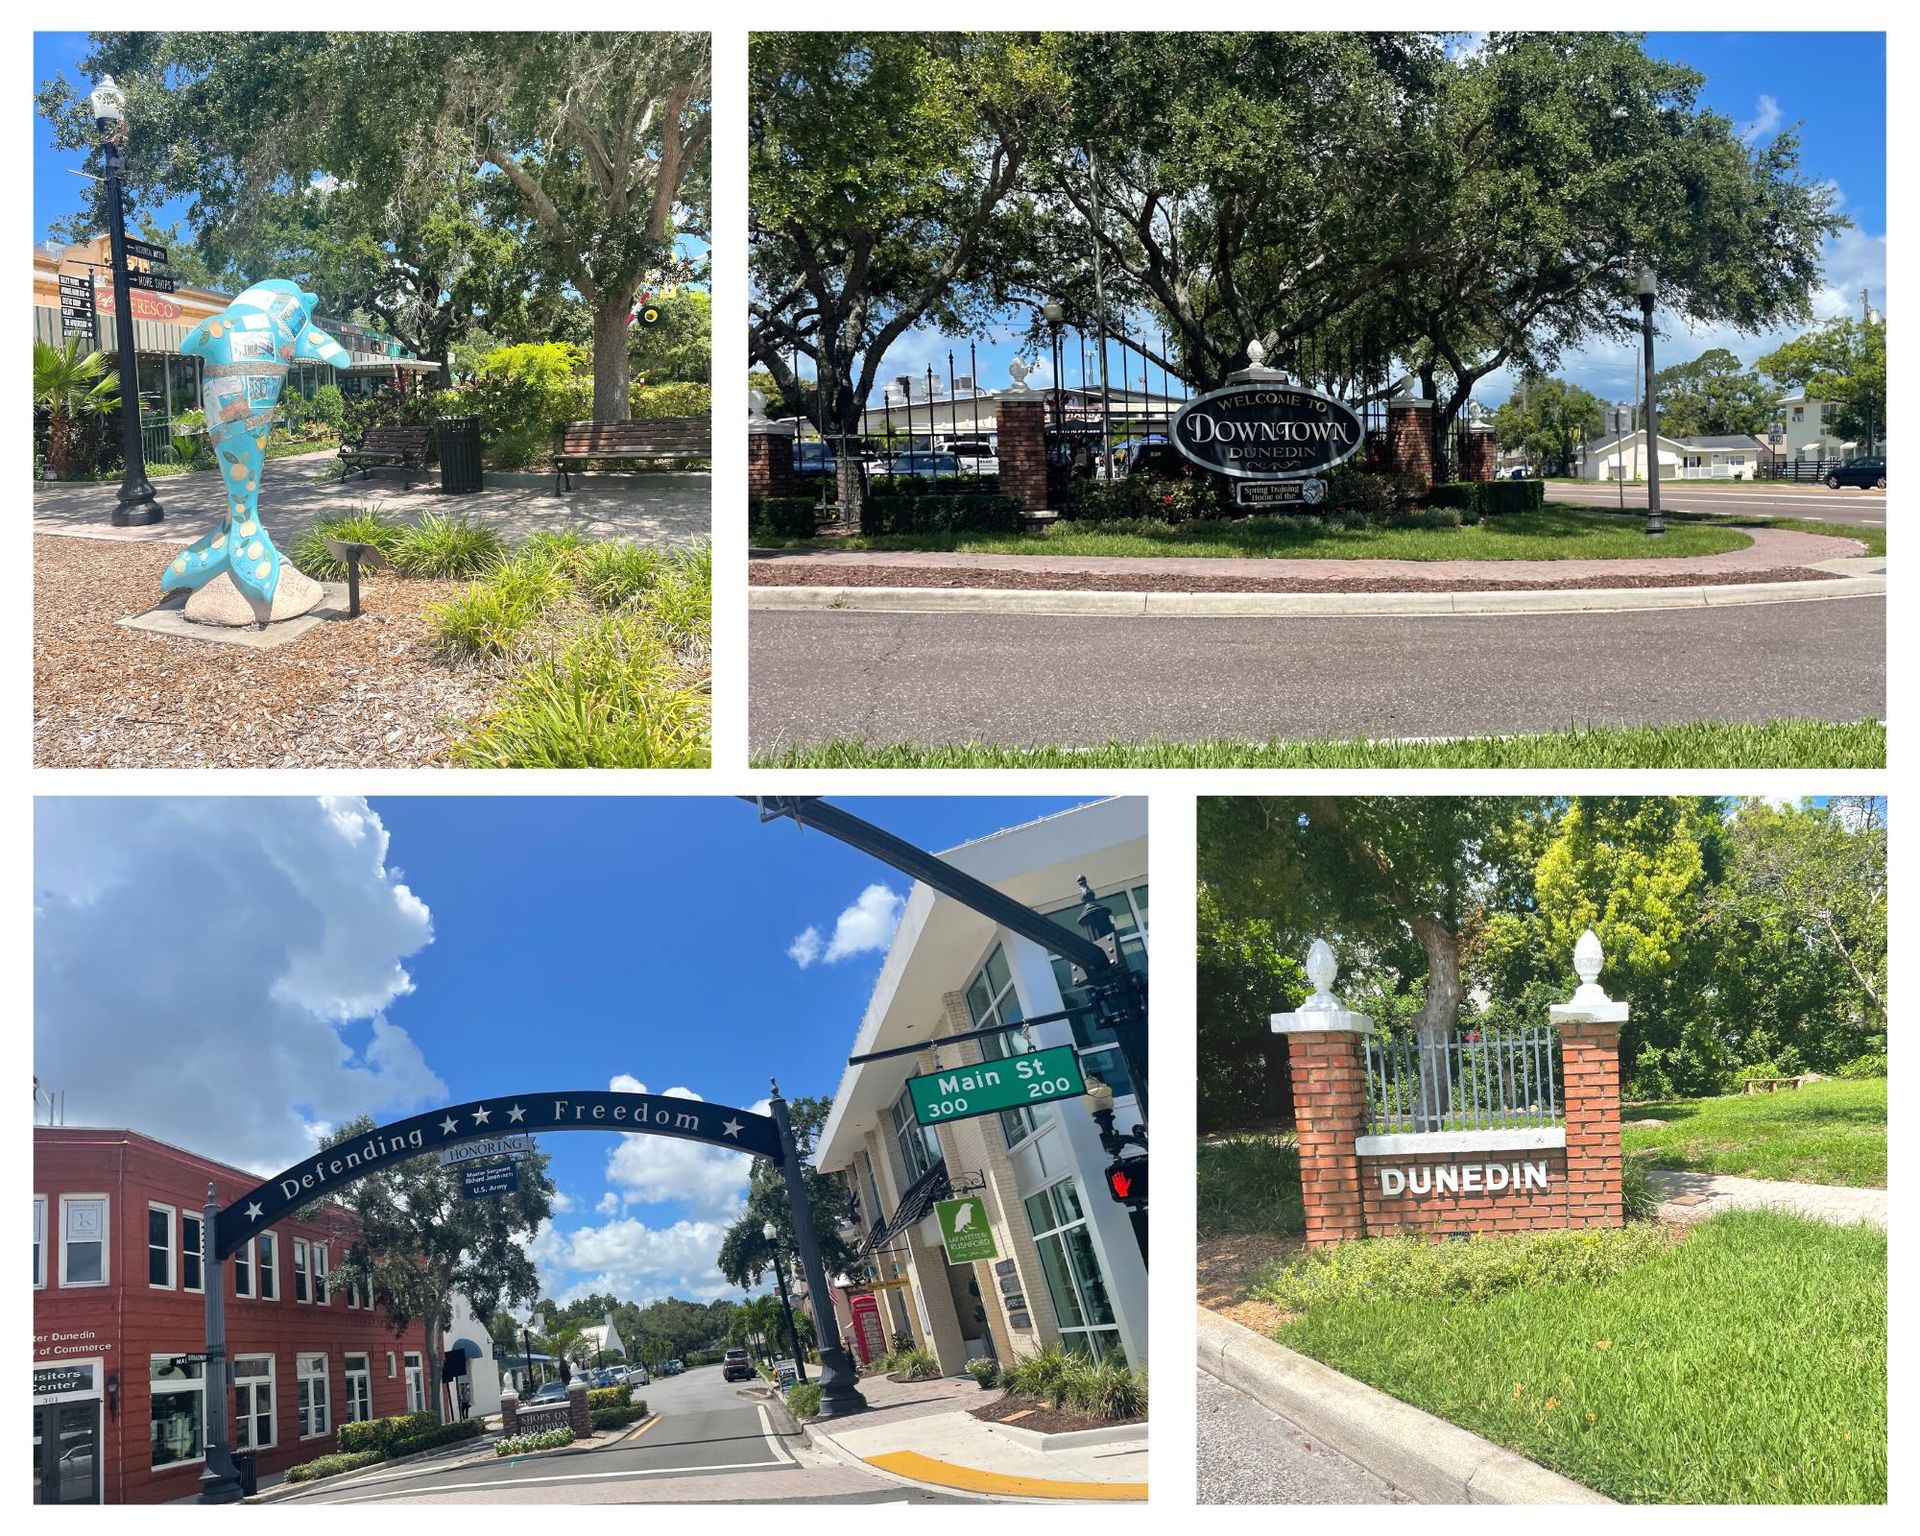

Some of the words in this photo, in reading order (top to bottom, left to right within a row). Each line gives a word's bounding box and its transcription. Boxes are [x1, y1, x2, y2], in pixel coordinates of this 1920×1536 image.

[138, 275, 154, 288] MORE
[155, 278, 172, 291] SHOPS
[1217, 392, 1301, 411] WELCOME
[1308, 399, 1328, 413] TO
[1229, 446, 1316, 459] DUNEDIN
[1244, 486, 1268, 495] Spring
[1270, 485, 1299, 494] Training
[1251, 493, 1274, 501] Home
[1284, 492, 1296, 500] the
[938, 1070, 1000, 1096] Main
[1015, 1058, 1045, 1080] St
[1027, 1077, 1070, 1098] 200
[927, 1098, 968, 1118] 300
[280, 1129, 423, 1200] Defending
[554, 1100, 700, 1131] Freedom
[449, 1138, 522, 1161] HONORING
[1380, 1161, 1548, 1197] DUNEDIN
[473, 1186, 488, 1194] U.S.
[489, 1183, 508, 1192] Army
[950, 1238, 990, 1250] RUSHFORD
[52, 1331, 95, 1341] Dunedin
[39, 1346, 51, 1355] of
[54, 1343, 112, 1354] Commerce
[42, 1396, 58, 1404] 301
[521, 1412, 551, 1424] SHOPS
[554, 1409, 569, 1419] ON
